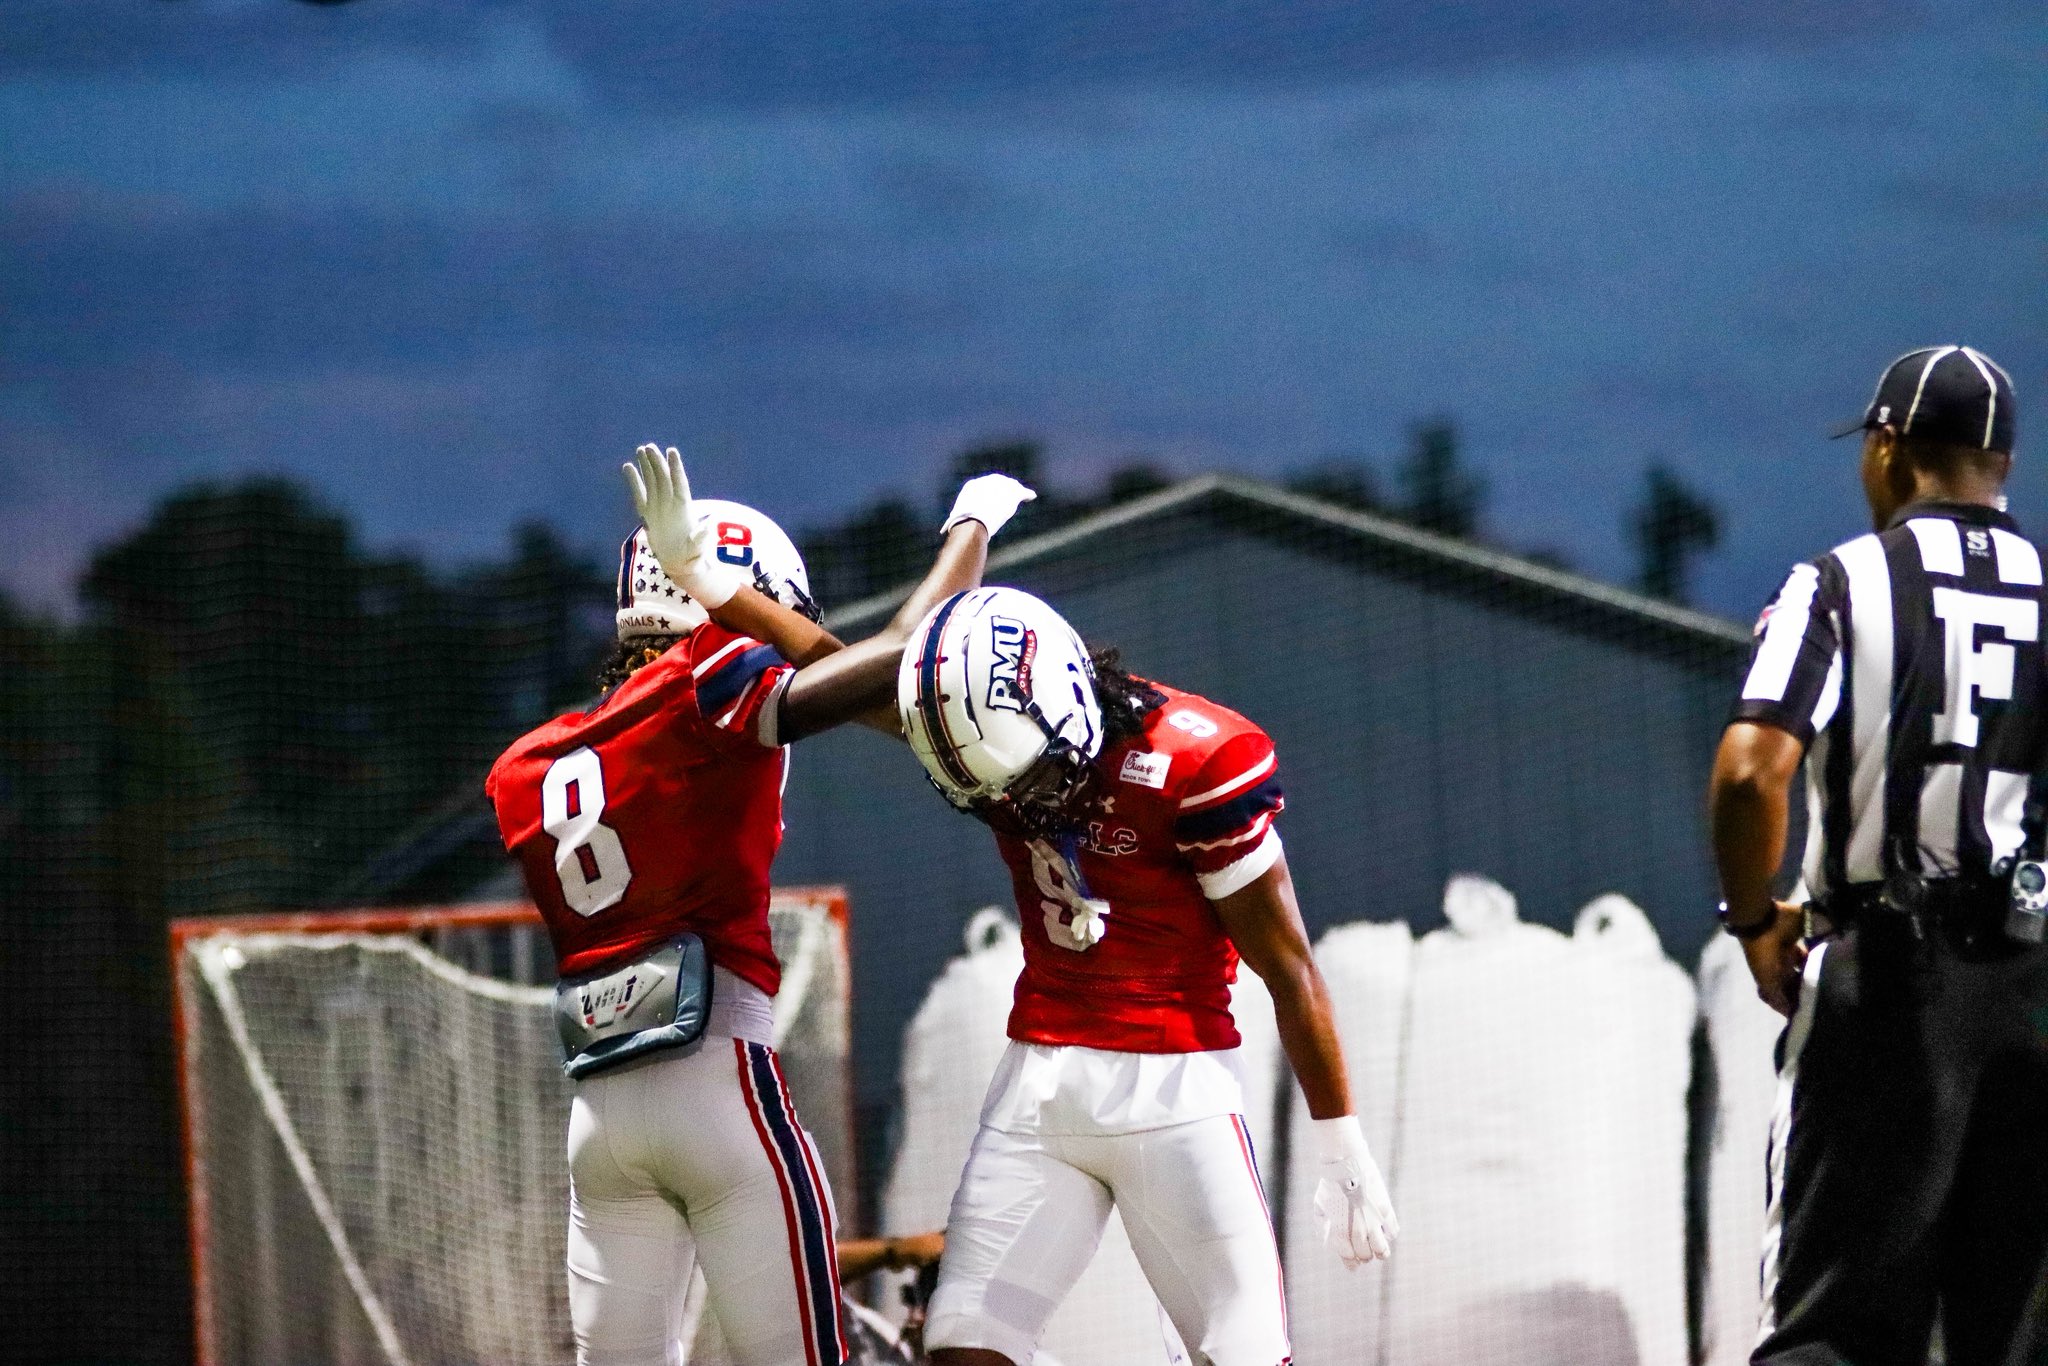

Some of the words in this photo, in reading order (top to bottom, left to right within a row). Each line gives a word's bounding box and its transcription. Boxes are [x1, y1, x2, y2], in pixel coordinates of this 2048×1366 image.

[717, 521, 753, 567] 8
[986, 615, 1026, 714] RMU
[1020, 634, 1035, 695] OLONIALS
[1932, 587, 2039, 748] F
[1168, 710, 1218, 738] 9
[542, 745, 633, 918] 8
[1025, 838, 1098, 952] 9
